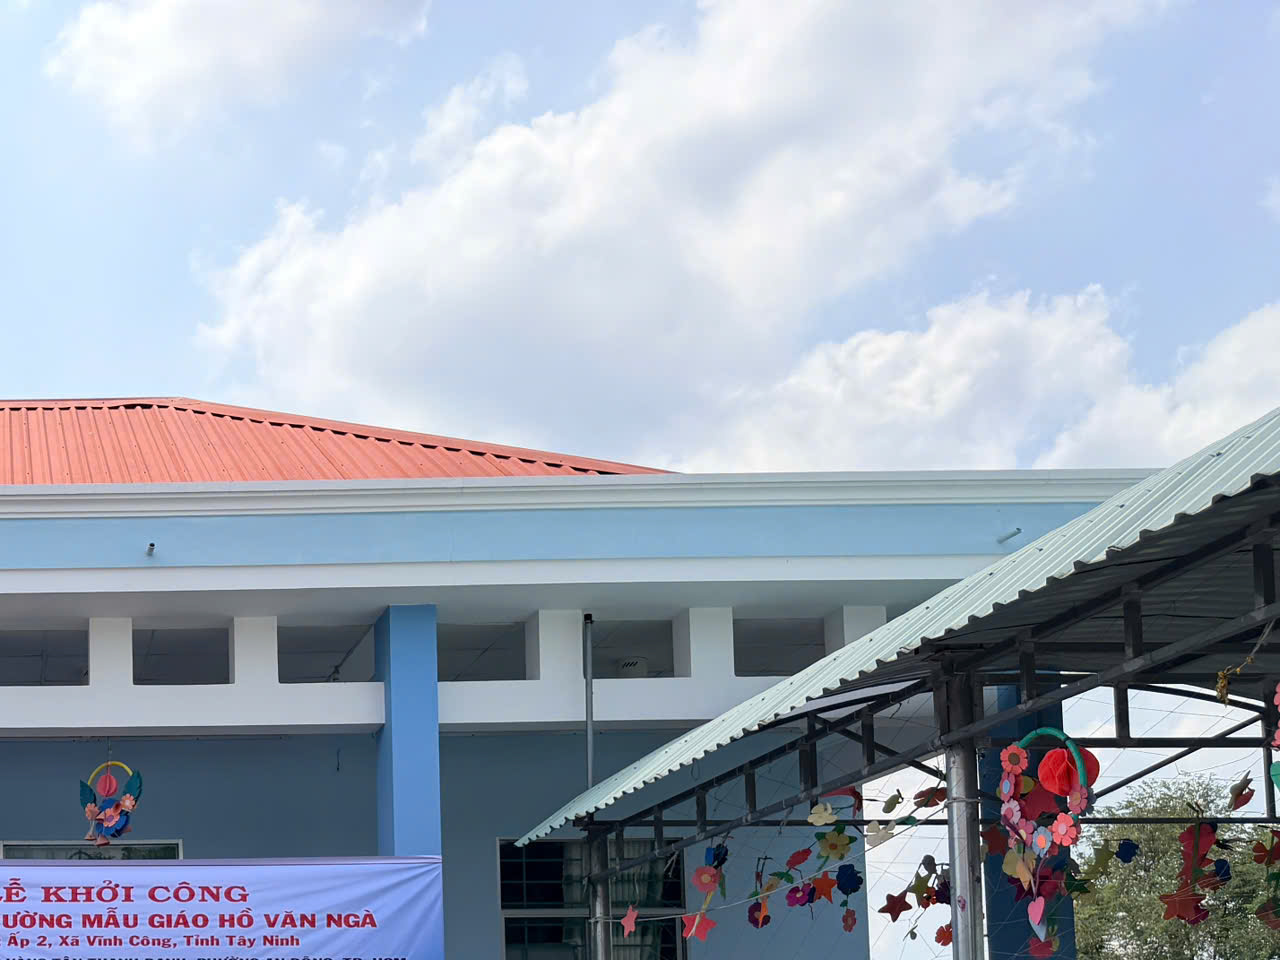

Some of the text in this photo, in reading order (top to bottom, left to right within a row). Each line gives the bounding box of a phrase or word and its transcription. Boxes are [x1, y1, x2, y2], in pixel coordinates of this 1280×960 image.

[40, 879, 135, 904] KHỞI
[147, 880, 250, 903] CÔNG
[81, 906, 139, 929] MẪU
[147, 909, 210, 929] GIÁO
[218, 907, 255, 929] HỒ
[263, 910, 319, 929] VĂN
[325, 909, 378, 929] NGÀ
[7, 930, 31, 949] Ấp
[36, 935, 53, 949] 2,
[58, 935, 81, 947] Xã
[85, 935, 124, 947] Vĩnh
[128, 934, 178, 949] Công,
[182, 934, 221, 947] Tỉnh
[224, 934, 257, 949] Tây
[262, 934, 301, 947] Ninh
